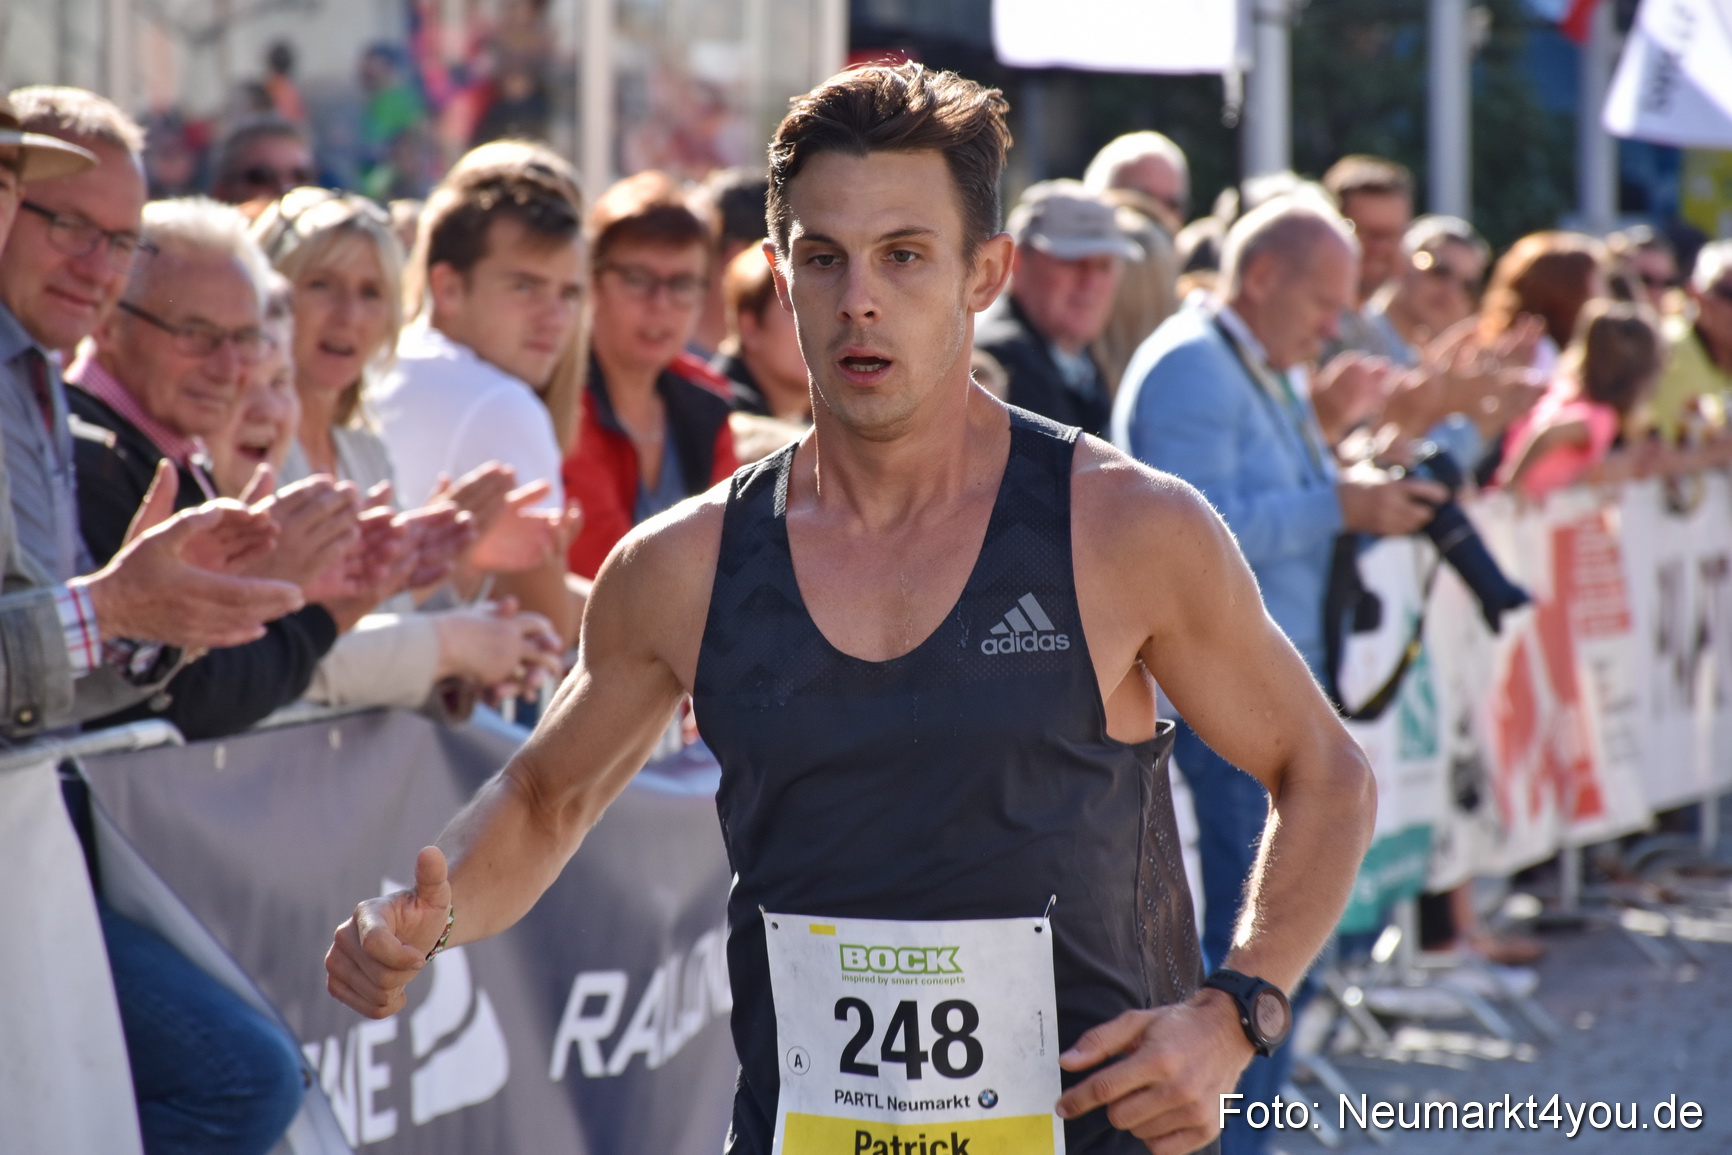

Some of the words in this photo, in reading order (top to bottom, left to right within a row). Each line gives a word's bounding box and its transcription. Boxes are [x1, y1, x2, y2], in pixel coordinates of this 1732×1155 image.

[981, 631, 1070, 655] adidas
[840, 944, 963, 974] BOCK
[841, 973, 876, 985] inspired
[877, 975, 889, 987] by
[891, 977, 918, 986] smart
[921, 976, 966, 986] concepts
[834, 996, 984, 1080] 248
[834, 1089, 884, 1109] PARTL
[887, 1094, 971, 1112] Neumarkt
[854, 1130, 971, 1155] Patrick
